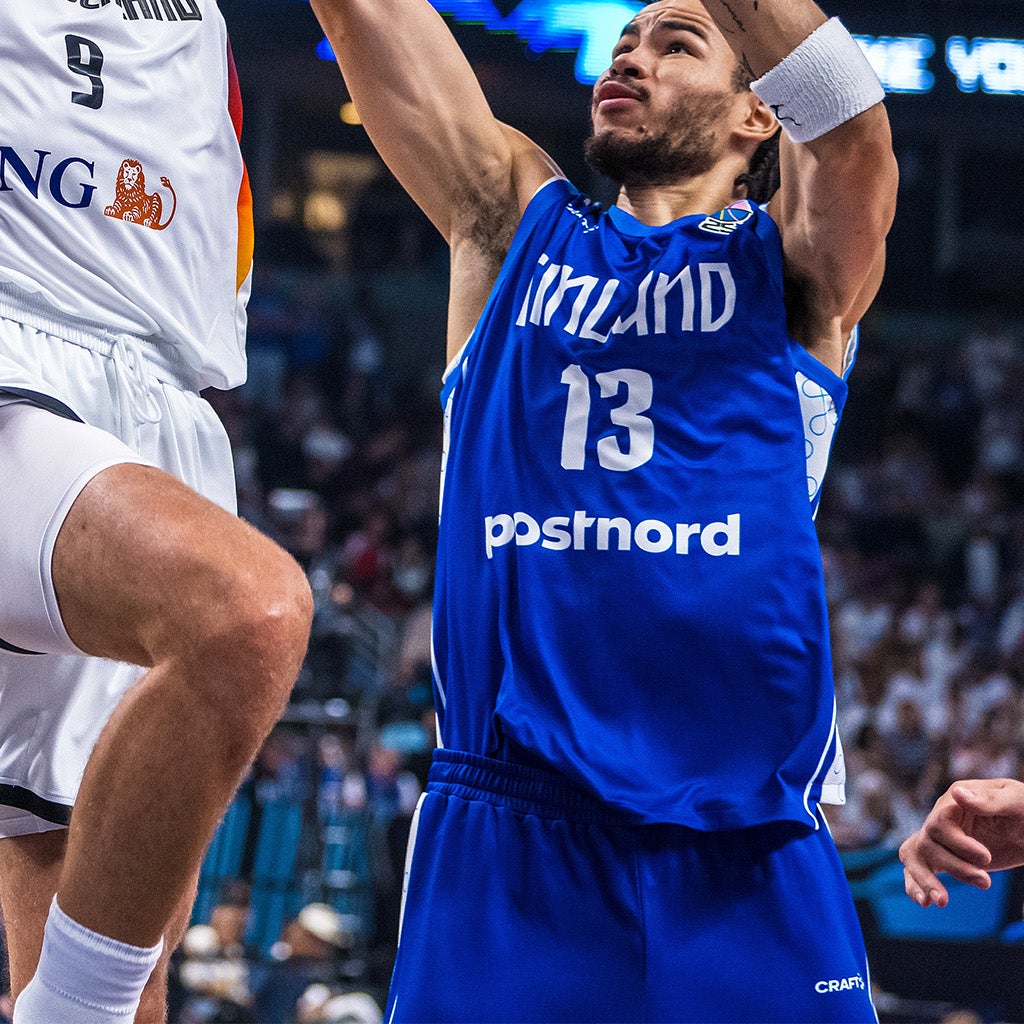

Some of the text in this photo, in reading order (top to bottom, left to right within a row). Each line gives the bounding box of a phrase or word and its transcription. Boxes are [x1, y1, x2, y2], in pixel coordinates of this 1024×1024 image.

[64, 34, 104, 110] 9
[560, 363, 655, 472] 13
[484, 510, 741, 559] postnord
[814, 976, 860, 994] CRAFT
